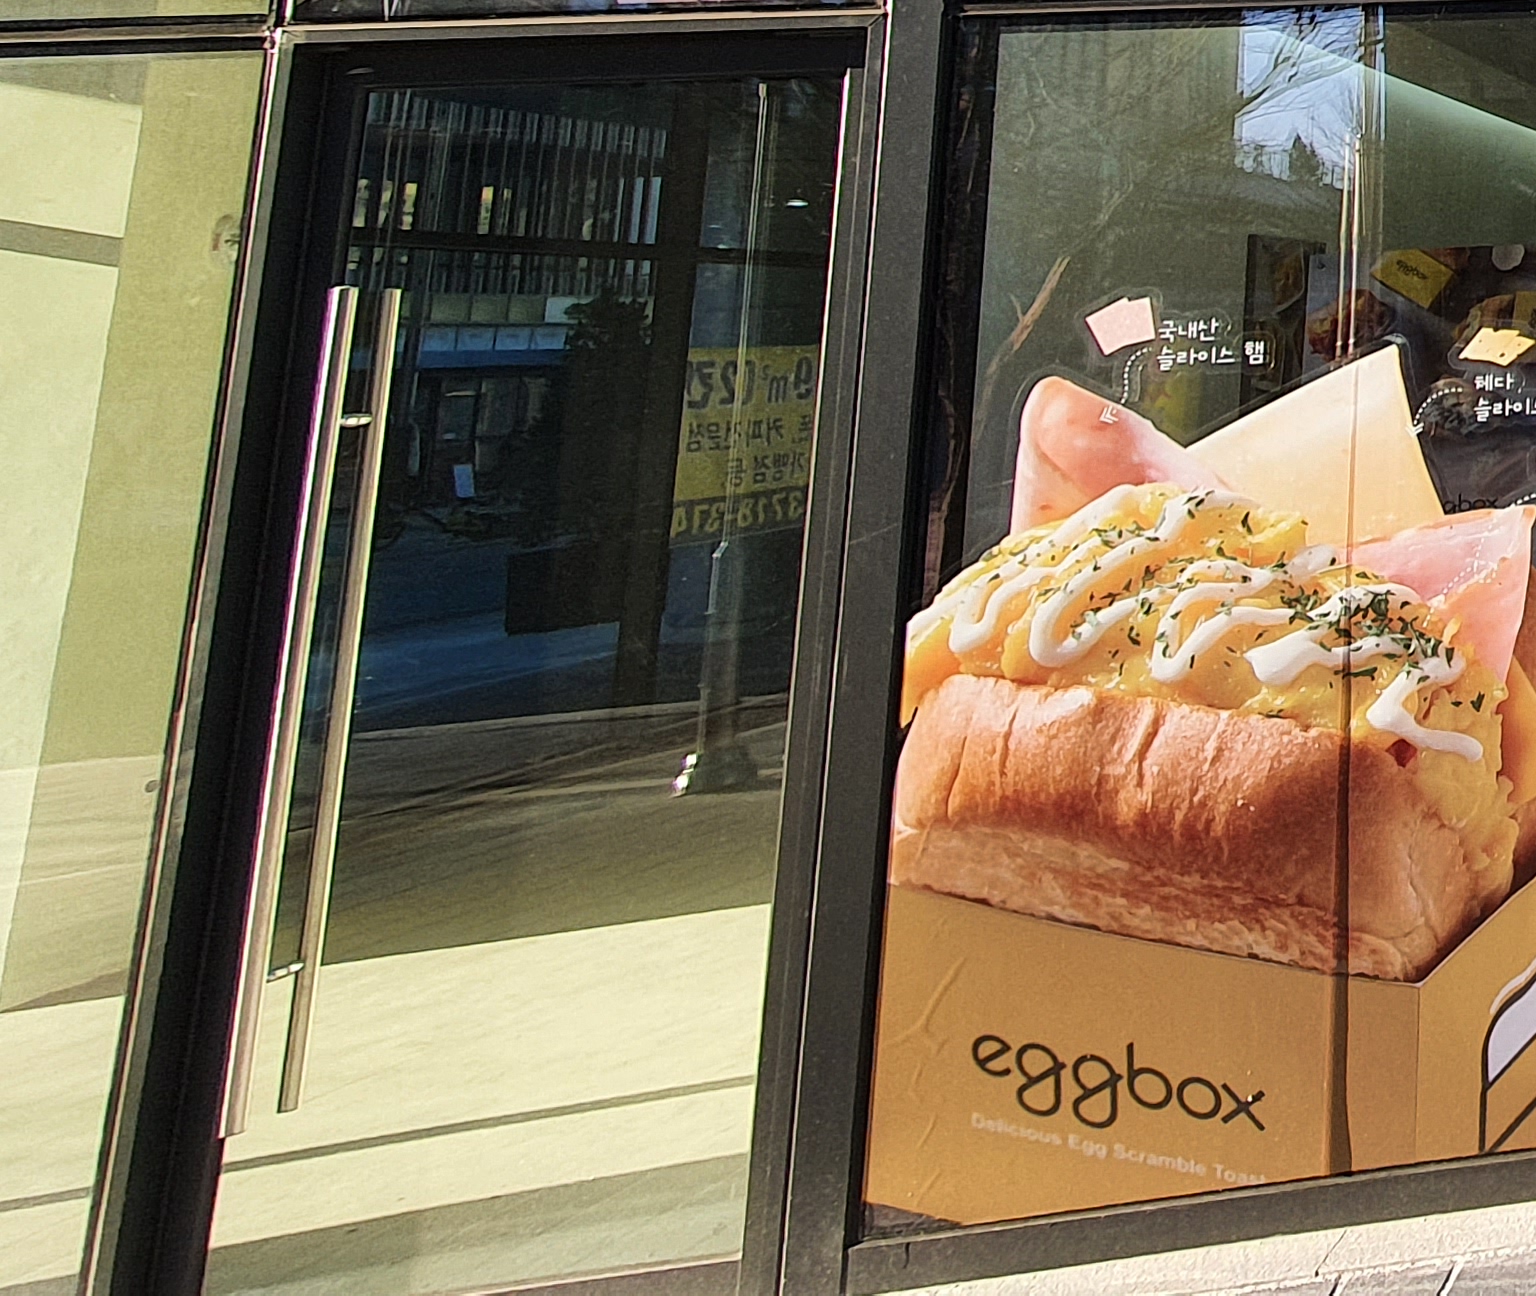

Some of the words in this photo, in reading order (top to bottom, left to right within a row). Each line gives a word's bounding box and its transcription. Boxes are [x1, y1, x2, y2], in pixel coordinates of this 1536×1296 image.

[1156, 345, 1236, 371] 슬라이스
[1244, 339, 1266, 367] 햄
[1158, 317, 1219, 344] 국내산
[971, 1034, 1267, 1131] eggbox
[969, 1112, 1064, 1147] Delicious
[1067, 1133, 1109, 1160] Egg
[1112, 1141, 1208, 1178] Scramble
